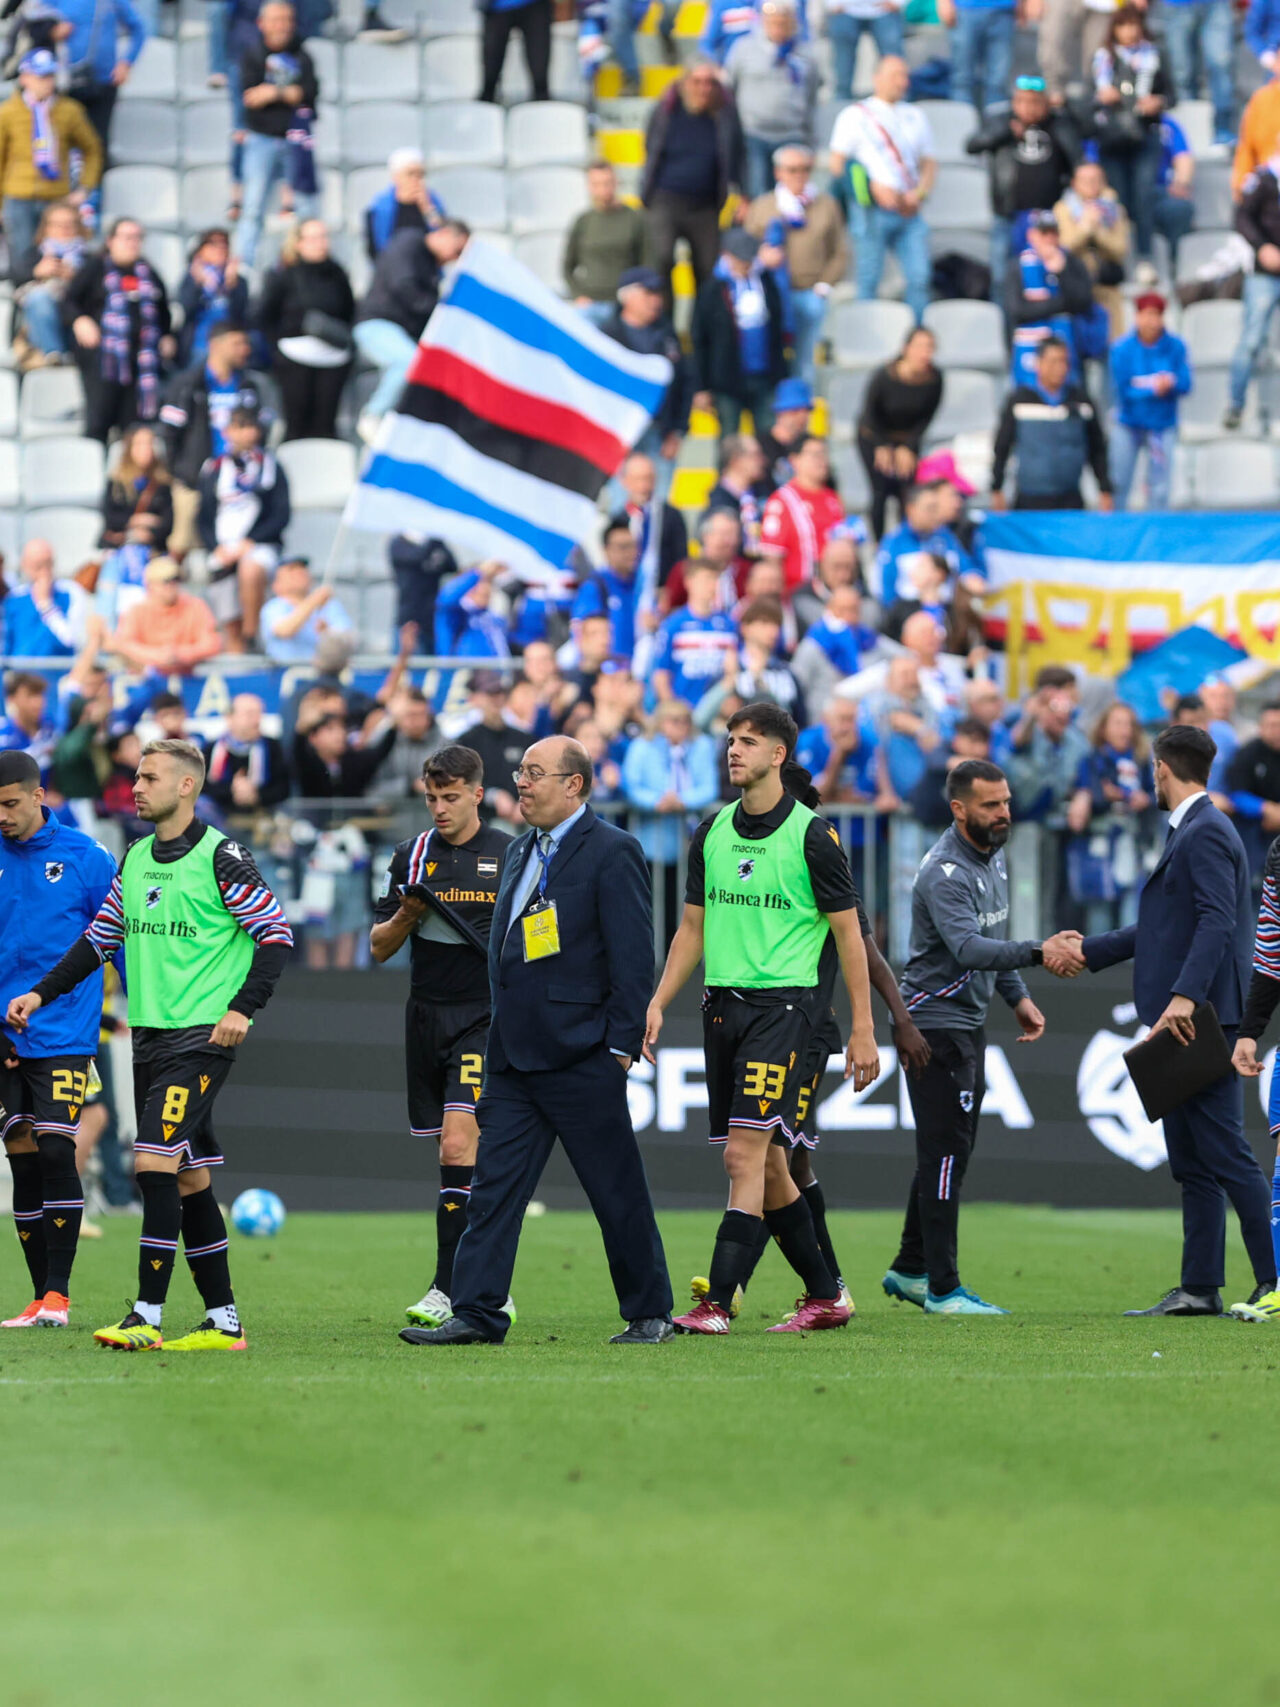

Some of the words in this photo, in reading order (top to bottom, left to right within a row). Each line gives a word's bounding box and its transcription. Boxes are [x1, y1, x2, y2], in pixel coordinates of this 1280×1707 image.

[732, 844, 766, 855] macron
[144, 871, 173, 880] macron
[719, 889, 761, 907] Banca
[763, 893, 792, 911] Ifis
[132, 918, 166, 935] Bnca
[169, 920, 197, 938] Ifis
[52, 1069, 87, 1105] 23
[626, 1045, 1035, 1133] PZIA
[743, 1061, 786, 1100] 33
[161, 1085, 190, 1124] 8
